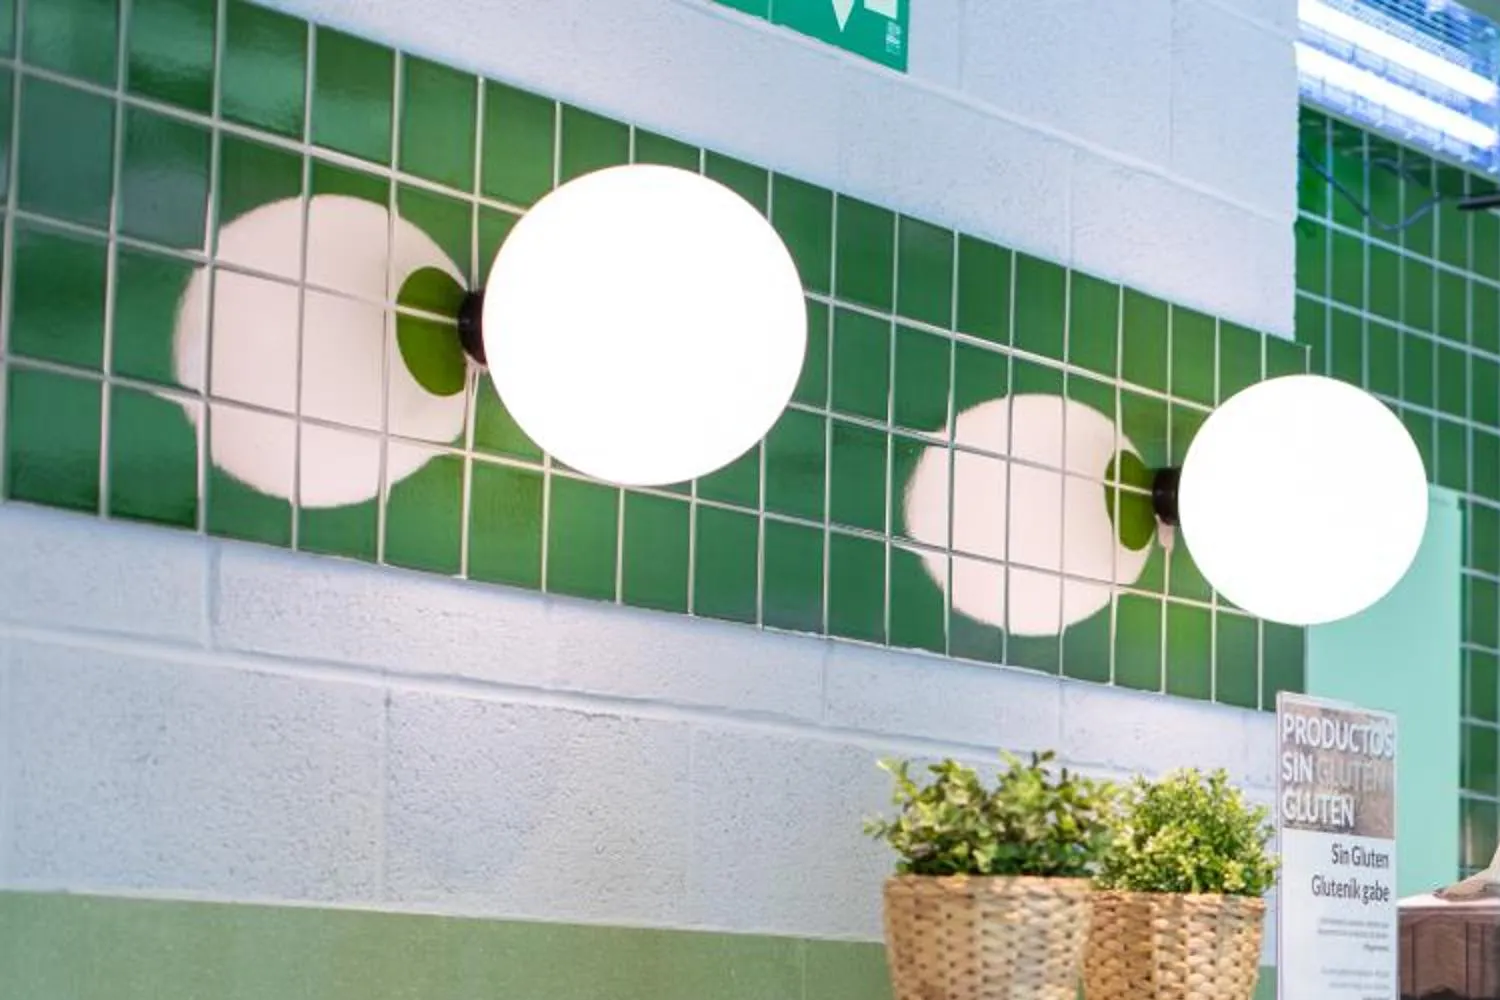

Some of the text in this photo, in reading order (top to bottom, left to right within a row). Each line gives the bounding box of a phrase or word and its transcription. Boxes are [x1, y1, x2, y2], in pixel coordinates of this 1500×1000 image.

[1282, 712, 1394, 758] PRODUCTOS
[1282, 751, 1313, 783] SIN
[1282, 790, 1355, 828] GLUTEN
[1331, 843, 1389, 869] Sin Gluten
[1362, 881, 1390, 904] gabe
